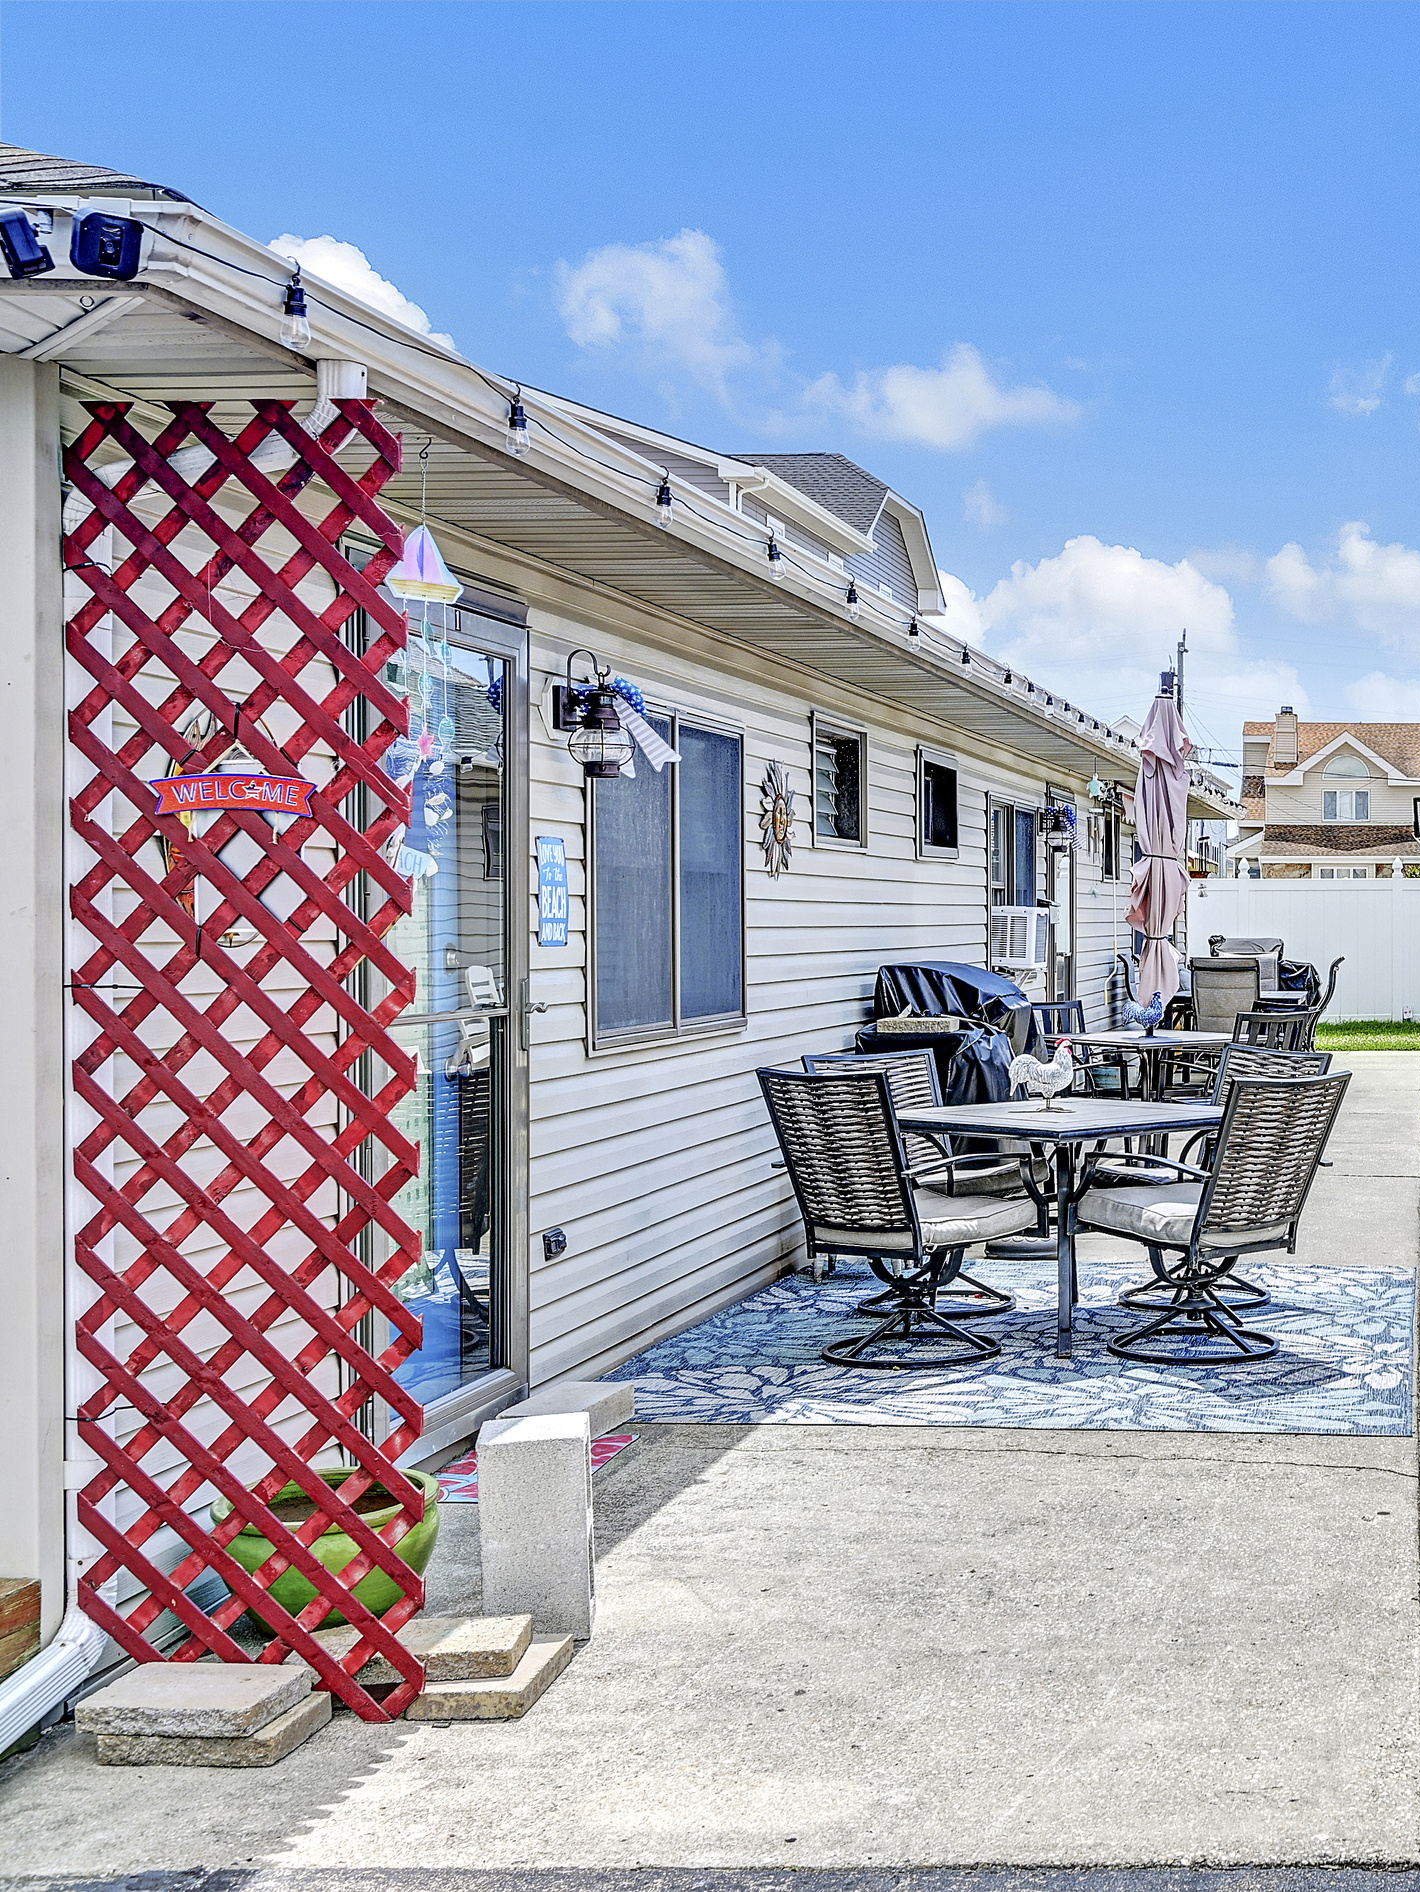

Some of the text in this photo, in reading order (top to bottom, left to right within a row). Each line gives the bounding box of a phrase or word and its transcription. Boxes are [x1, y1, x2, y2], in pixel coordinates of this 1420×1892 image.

[171, 780, 299, 806] WELCOME
[538, 843, 565, 867] LOVE YOU
[543, 867, 552, 882] To
[542, 885, 567, 919] BEACH
[541, 922, 566, 942] AND BACK
